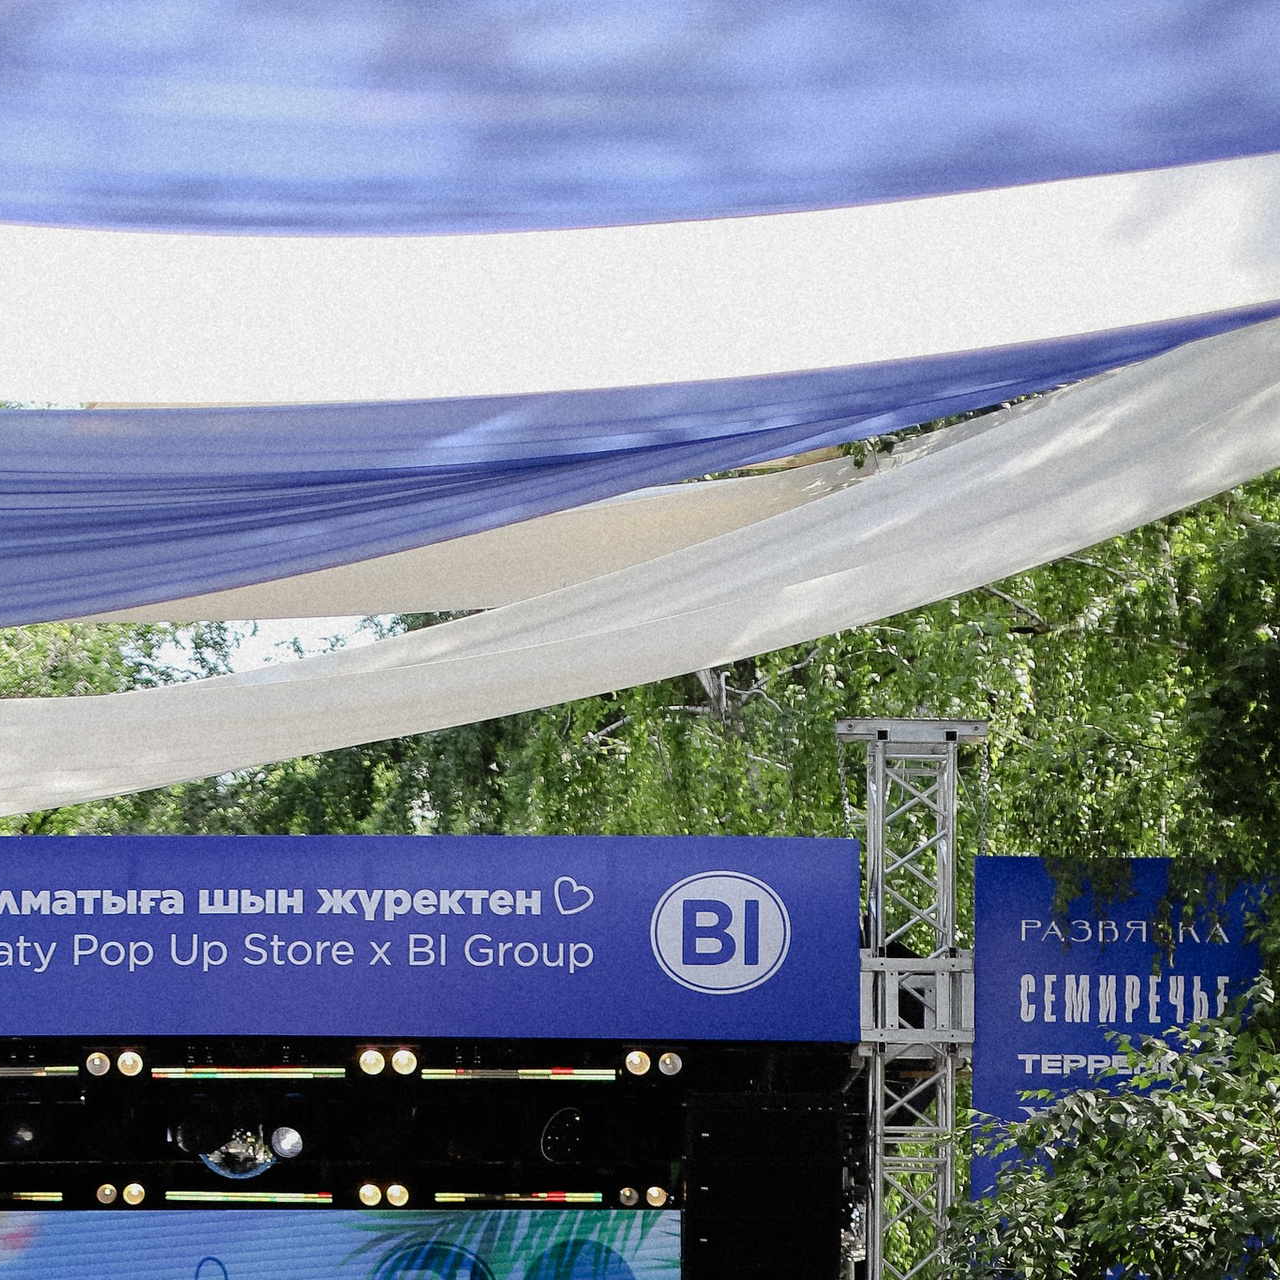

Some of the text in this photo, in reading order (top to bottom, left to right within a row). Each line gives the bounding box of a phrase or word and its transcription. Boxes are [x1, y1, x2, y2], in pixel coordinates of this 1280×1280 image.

[199, 886, 304, 914] шын
[317, 886, 541, 921] жүректен
[682, 899, 759, 965] BI
[1021, 919, 1230, 943] РАЗВЯКА
[73, 934, 154, 973] Pop
[170, 934, 228, 973] Up
[243, 933, 354, 967] Store
[409, 935, 447, 967] BI
[463, 934, 594, 973] Group
